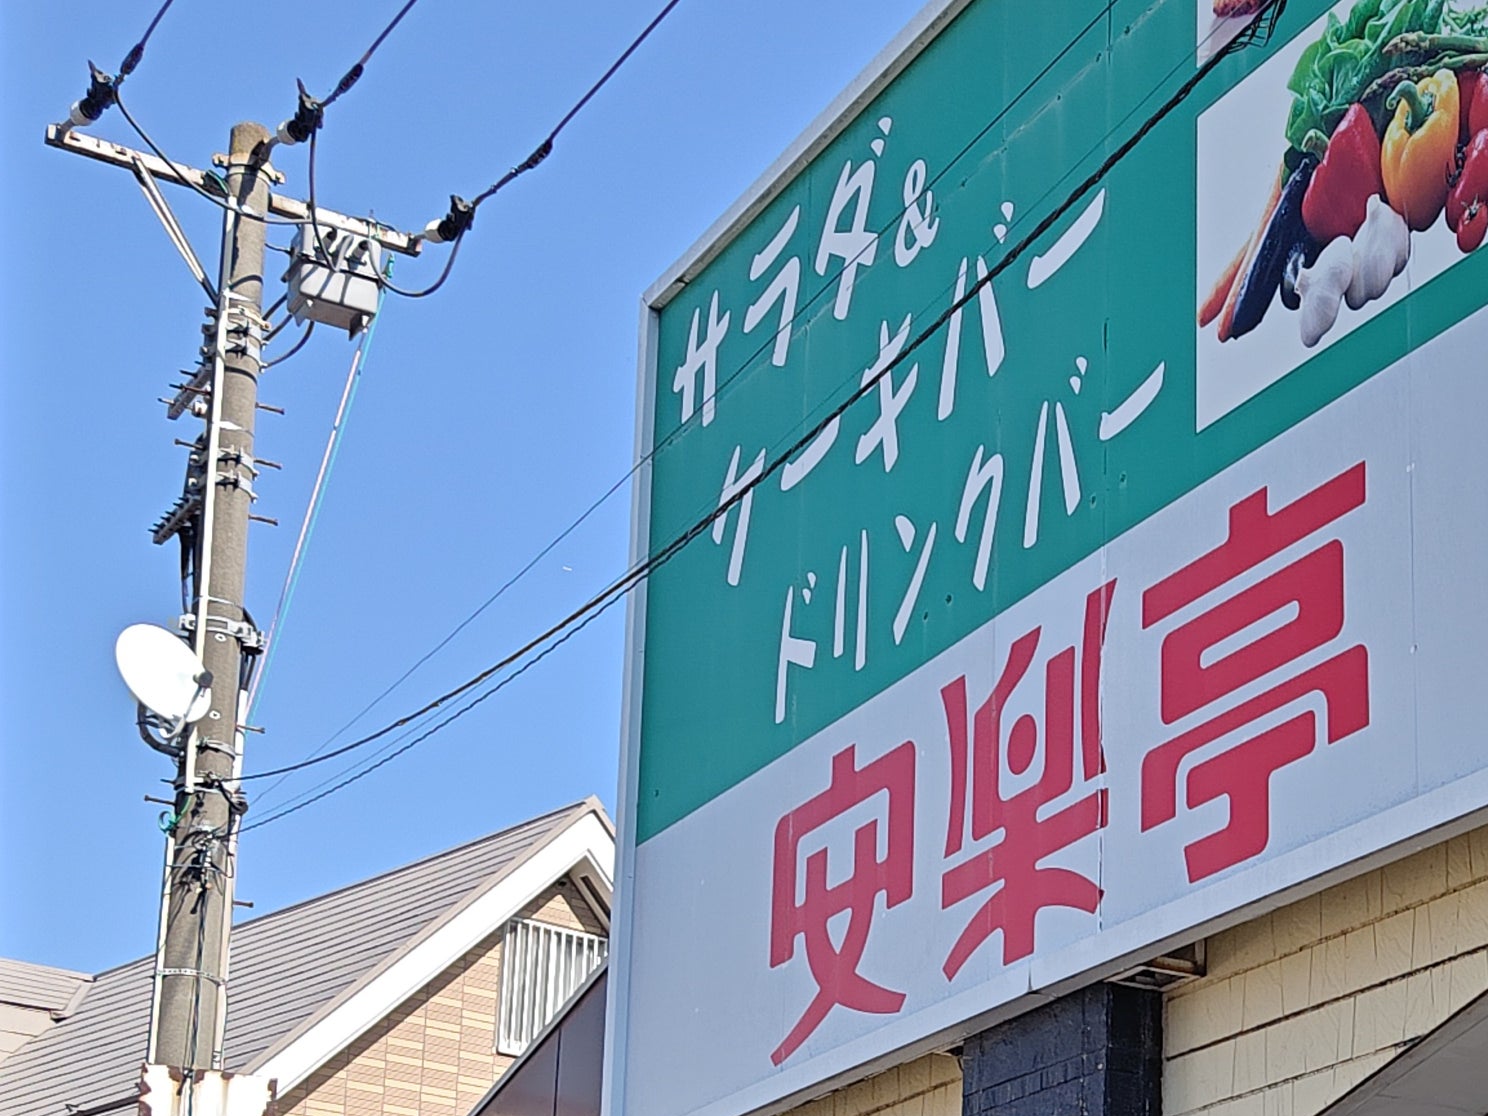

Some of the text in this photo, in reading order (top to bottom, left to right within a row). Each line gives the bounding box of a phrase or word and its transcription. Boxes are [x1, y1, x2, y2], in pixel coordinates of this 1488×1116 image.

[713, 188, 1106, 587] ケーキバー
[775, 356, 1166, 724] ドリンクバー
[769, 461, 1369, 1067] 安楽亭
